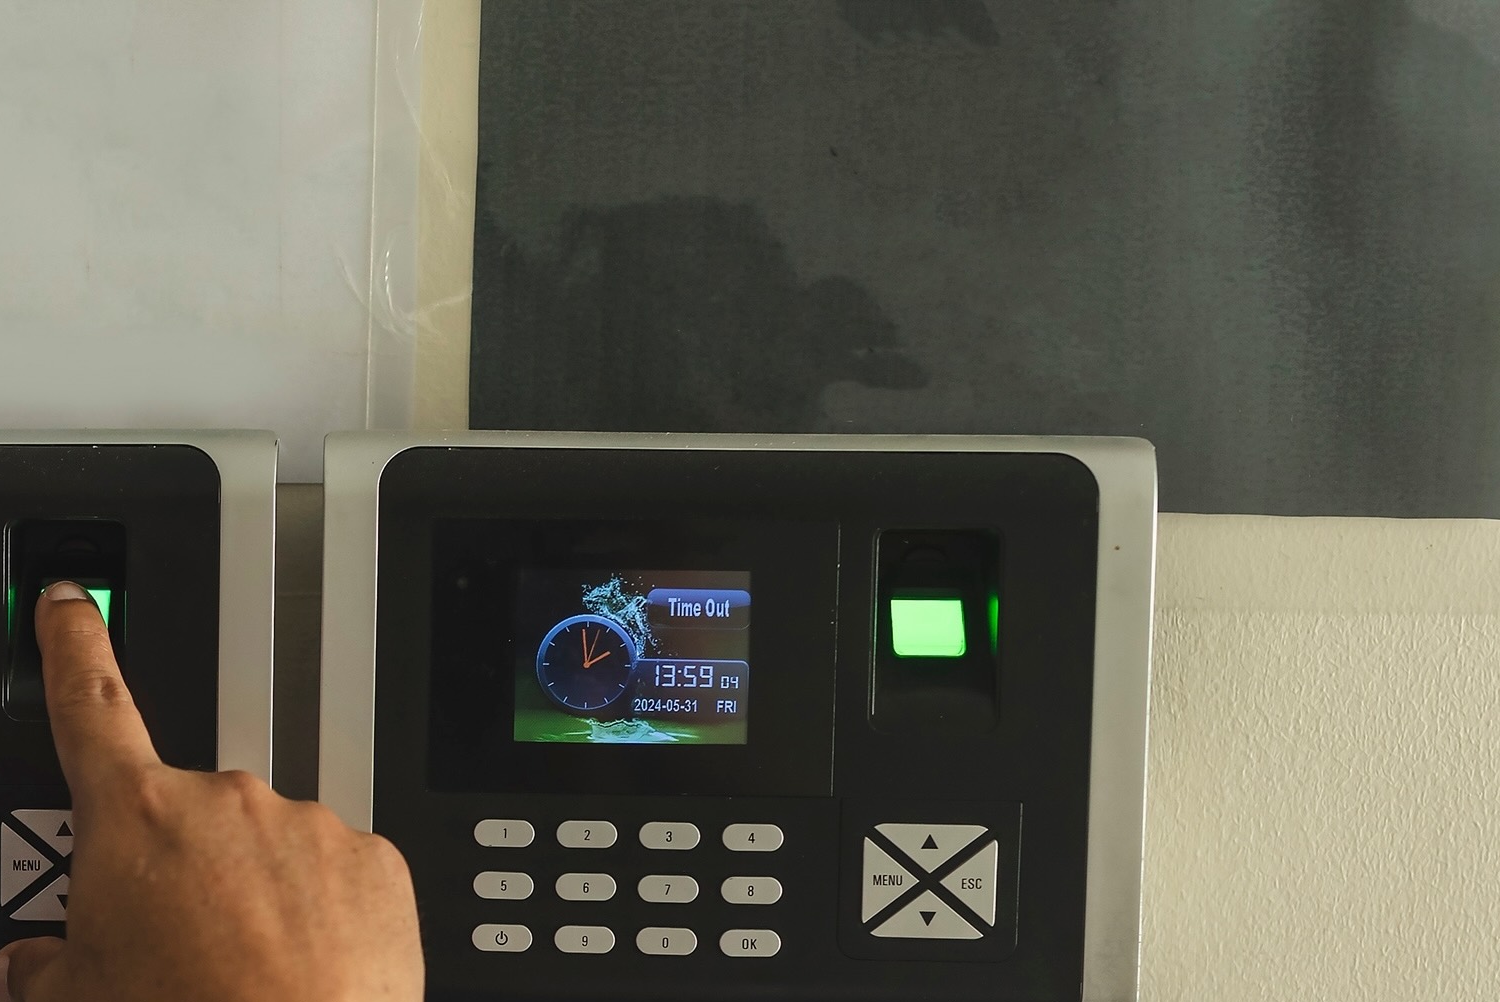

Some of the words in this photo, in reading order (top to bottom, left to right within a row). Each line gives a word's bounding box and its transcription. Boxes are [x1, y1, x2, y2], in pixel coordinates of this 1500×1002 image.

[668, 598, 701, 617] Time
[706, 599, 730, 617] Out
[655, 665, 714, 688] 13:59
[720, 676, 738, 689] 04
[634, 699, 698, 712] 2024-05-31
[716, 700, 737, 713] FRI
[583, 829, 591, 841] 2
[665, 830, 673, 843] 3
[747, 832, 756, 844] 4
[12, 859, 41, 872] MENU
[500, 879, 507, 892] 5
[872, 874, 903, 886] MENU
[961, 877, 982, 890] ESC
[582, 881, 590, 894] 6
[664, 883, 671, 896] 7
[747, 885, 755, 897] 8
[581, 935, 589, 947] 9
[661, 937, 669, 949] 0
[741, 938, 757, 950] OK
